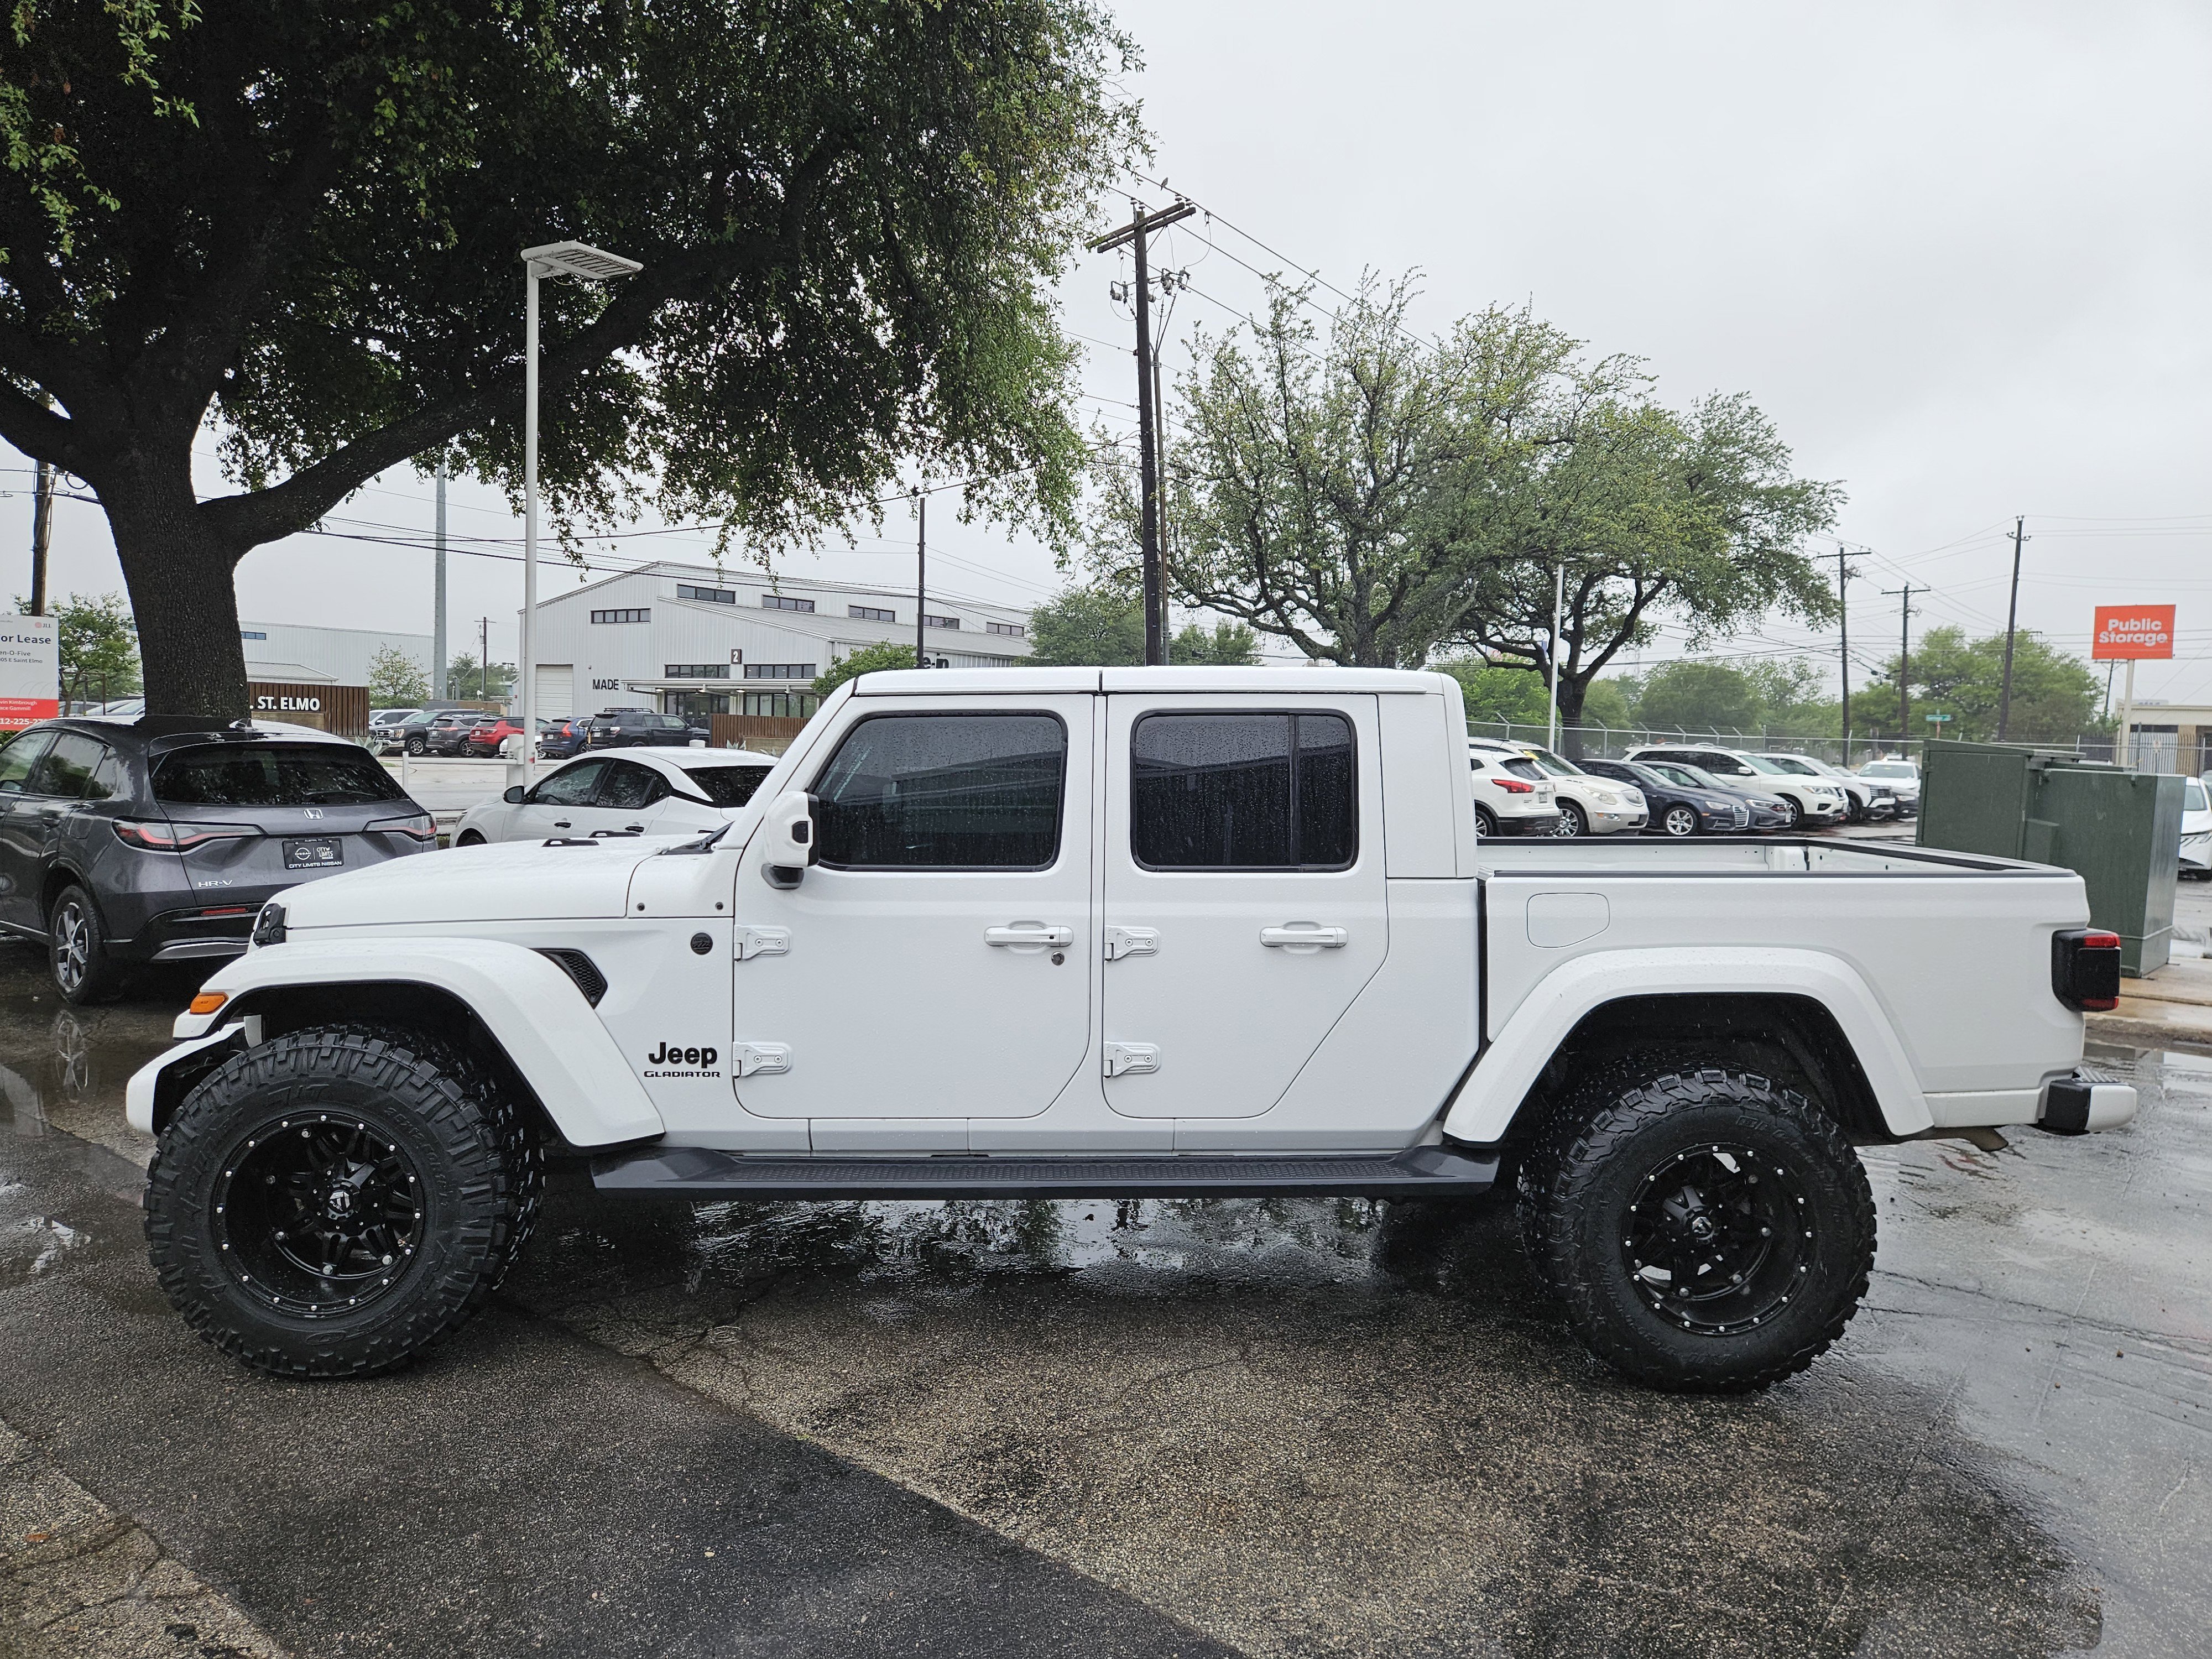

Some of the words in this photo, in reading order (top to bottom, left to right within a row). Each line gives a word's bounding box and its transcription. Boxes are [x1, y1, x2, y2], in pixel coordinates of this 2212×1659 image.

[2108, 618, 2162, 631] Public
[18, 635, 51, 644] Lease
[2099, 631, 2168, 647] Storage
[733, 651, 739, 662] 2
[593, 679, 619, 690] MADE
[257, 696, 277, 709] ST.
[280, 697, 320, 711] ELMO
[198, 879, 233, 888] HR-V
[648, 1041, 717, 1068] Jeep
